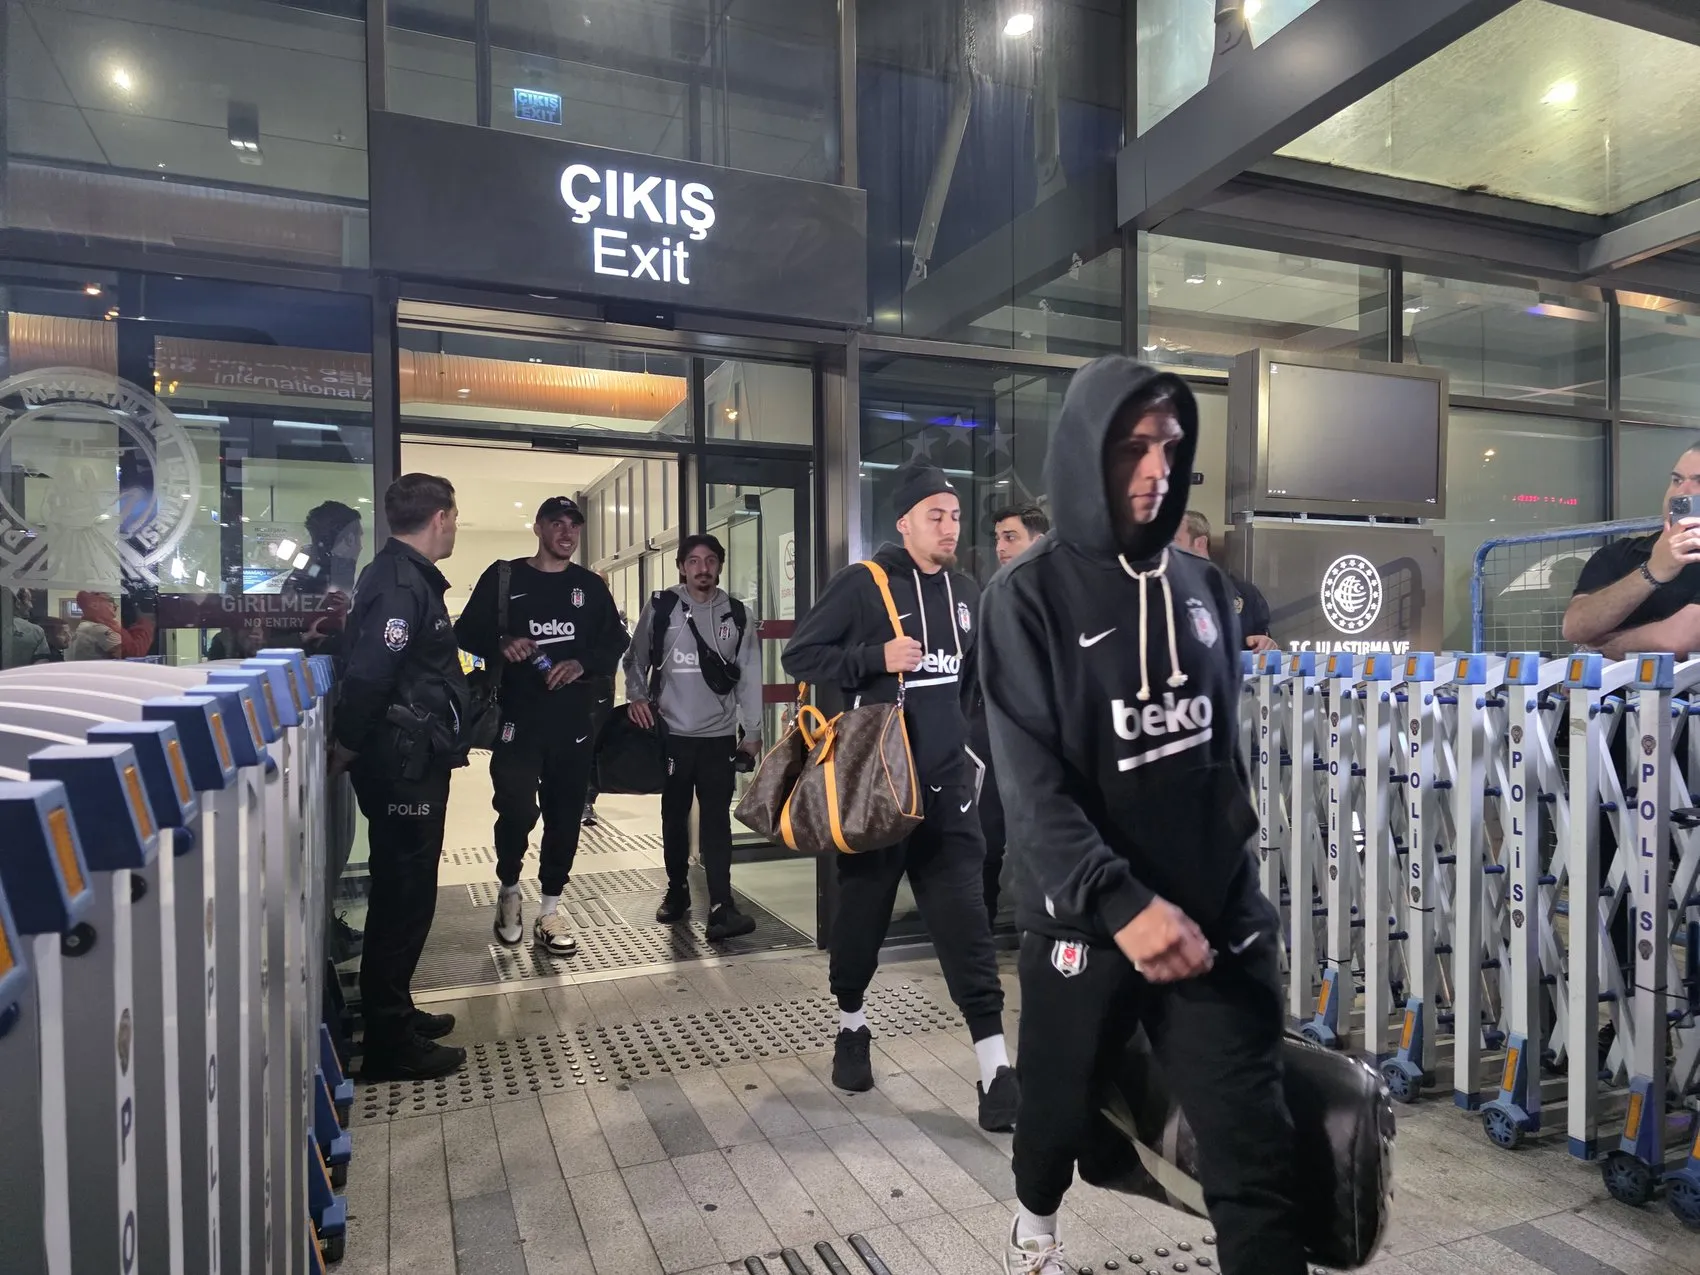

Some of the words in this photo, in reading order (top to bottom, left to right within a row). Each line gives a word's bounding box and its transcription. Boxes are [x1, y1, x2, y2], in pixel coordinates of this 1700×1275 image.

[518, 92, 559, 111] ÇIKIŞ
[522, 106, 556, 121] EXIT
[560, 164, 716, 240] ÇIKIŞ
[593, 227, 690, 284] Exit
[214, 371, 356, 399] International
[244, 618, 262, 628] NO
[265, 618, 304, 628] ENTRY
[529, 619, 575, 635] beko
[912, 649, 960, 674] eko
[1111, 692, 1212, 740] beko
